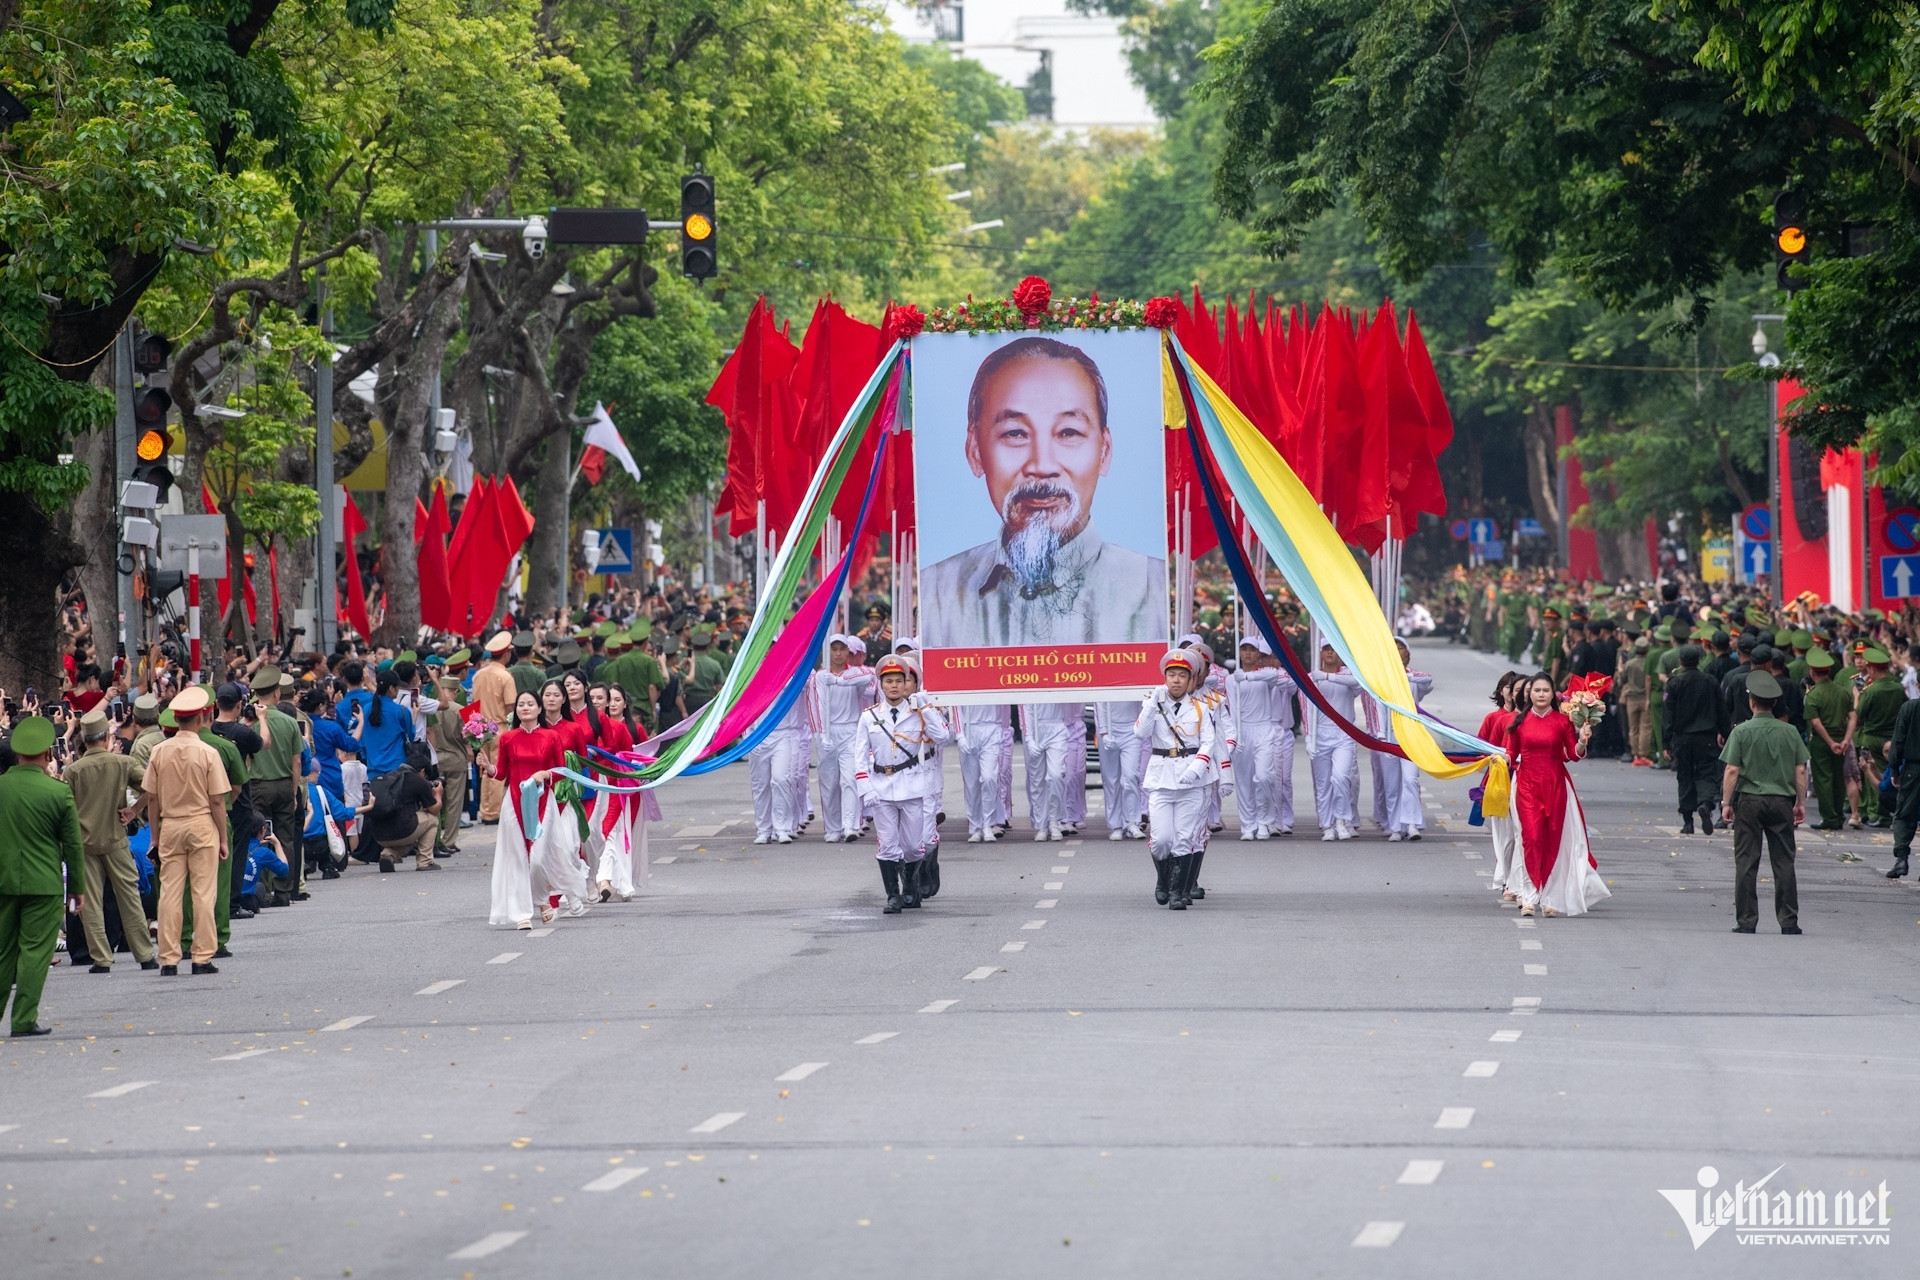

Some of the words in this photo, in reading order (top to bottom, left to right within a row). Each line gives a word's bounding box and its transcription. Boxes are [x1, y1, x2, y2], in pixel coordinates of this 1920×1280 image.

[943, 653, 981, 669] CHỦ
[985, 655, 1029, 670] TỊCH
[1033, 650, 1059, 666] HỒ
[1063, 650, 1096, 665] CHÍ
[1099, 652, 1147, 664] MINH
[1000, 672, 1039, 687] (1890
[1053, 671, 1093, 684] 1969)
